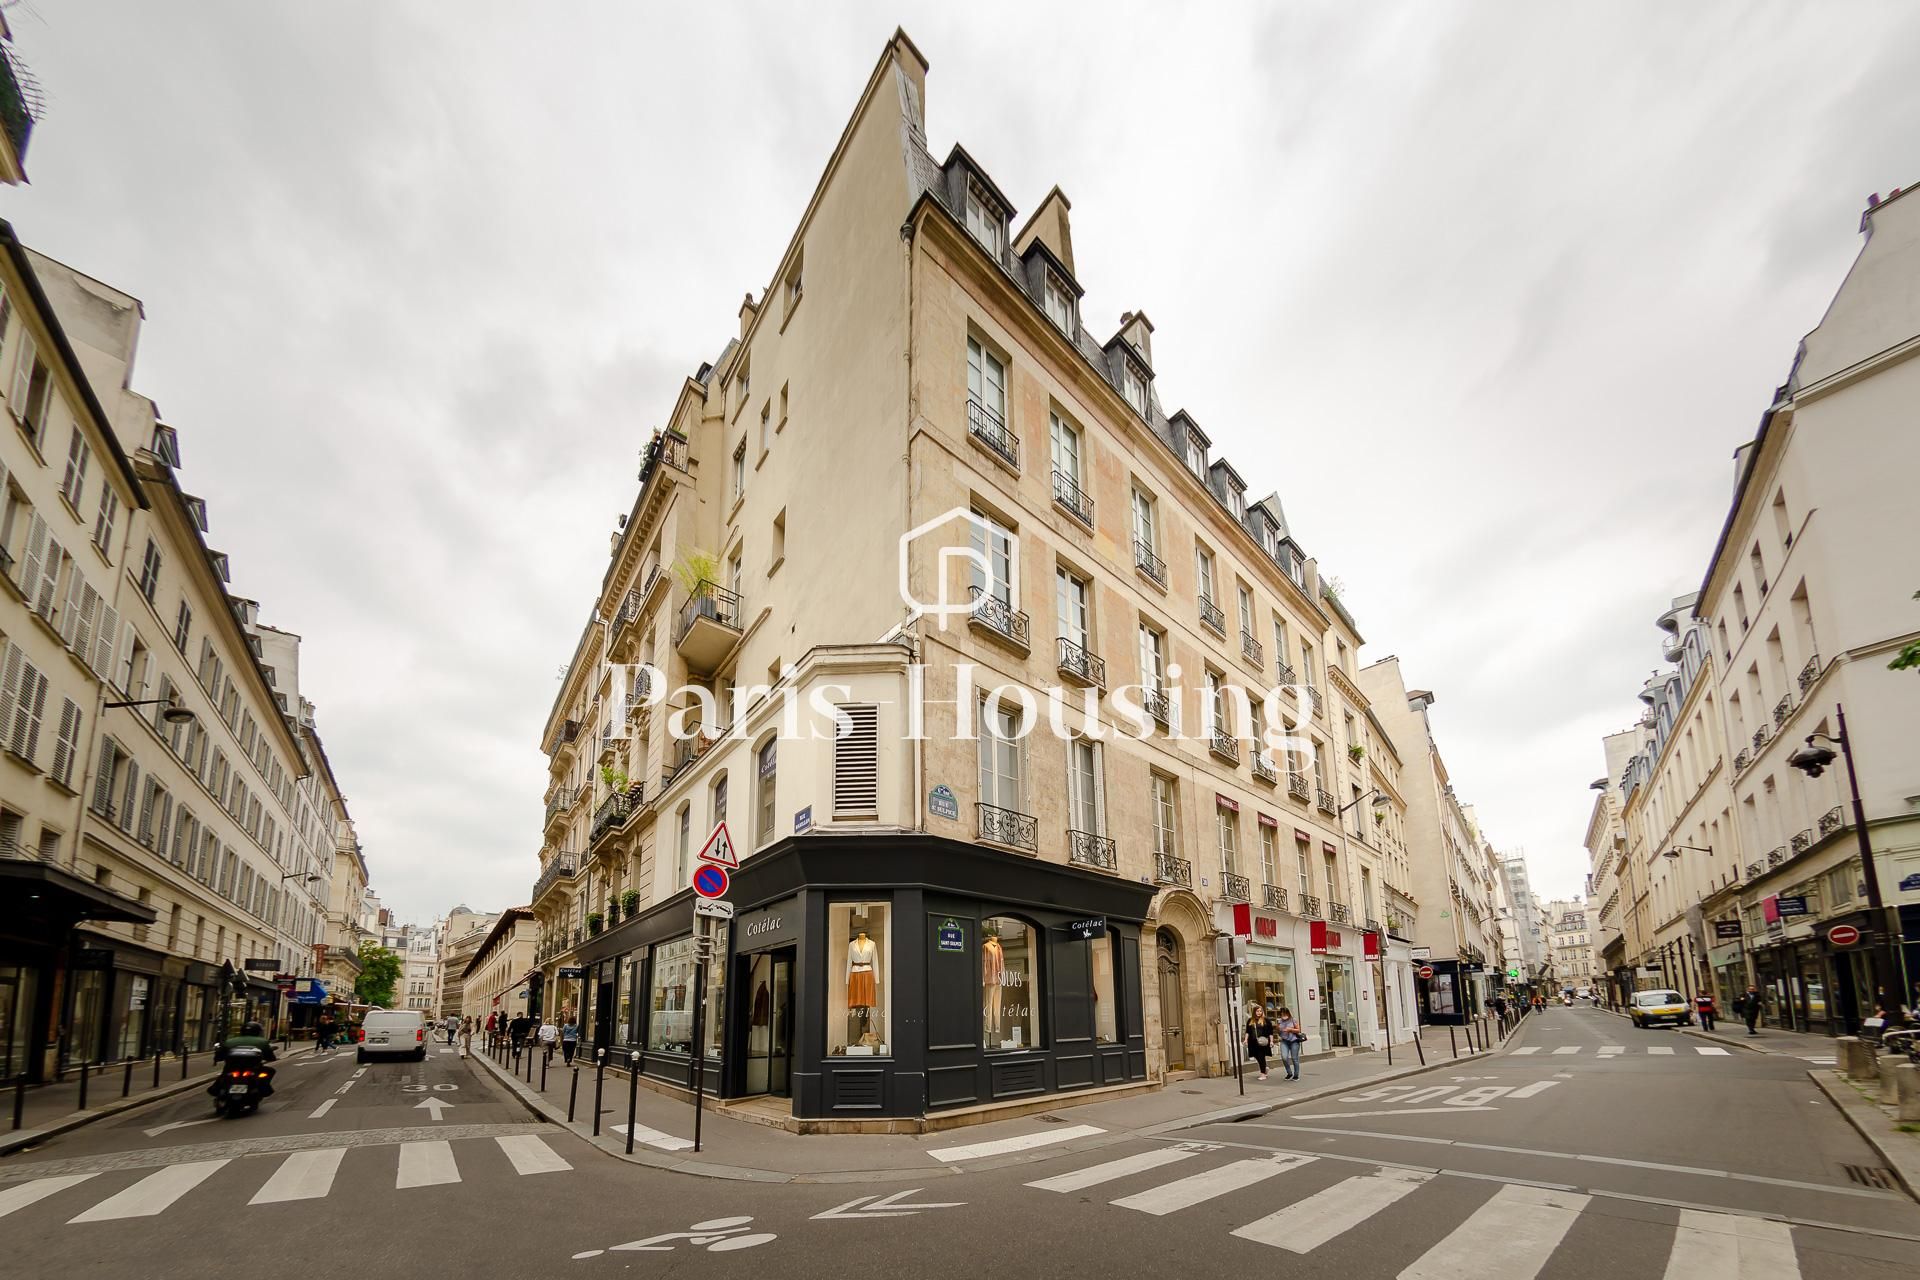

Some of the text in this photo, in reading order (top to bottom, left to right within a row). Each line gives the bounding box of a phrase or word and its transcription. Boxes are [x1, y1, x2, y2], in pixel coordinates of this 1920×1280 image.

[747, 917, 781, 937] Cotélac
[1072, 920, 1103, 930] Cotélac
[998, 970, 1023, 988] SOLDES
[401, 1083, 459, 1092] 30
[1337, 1085, 1517, 1107] BUS
